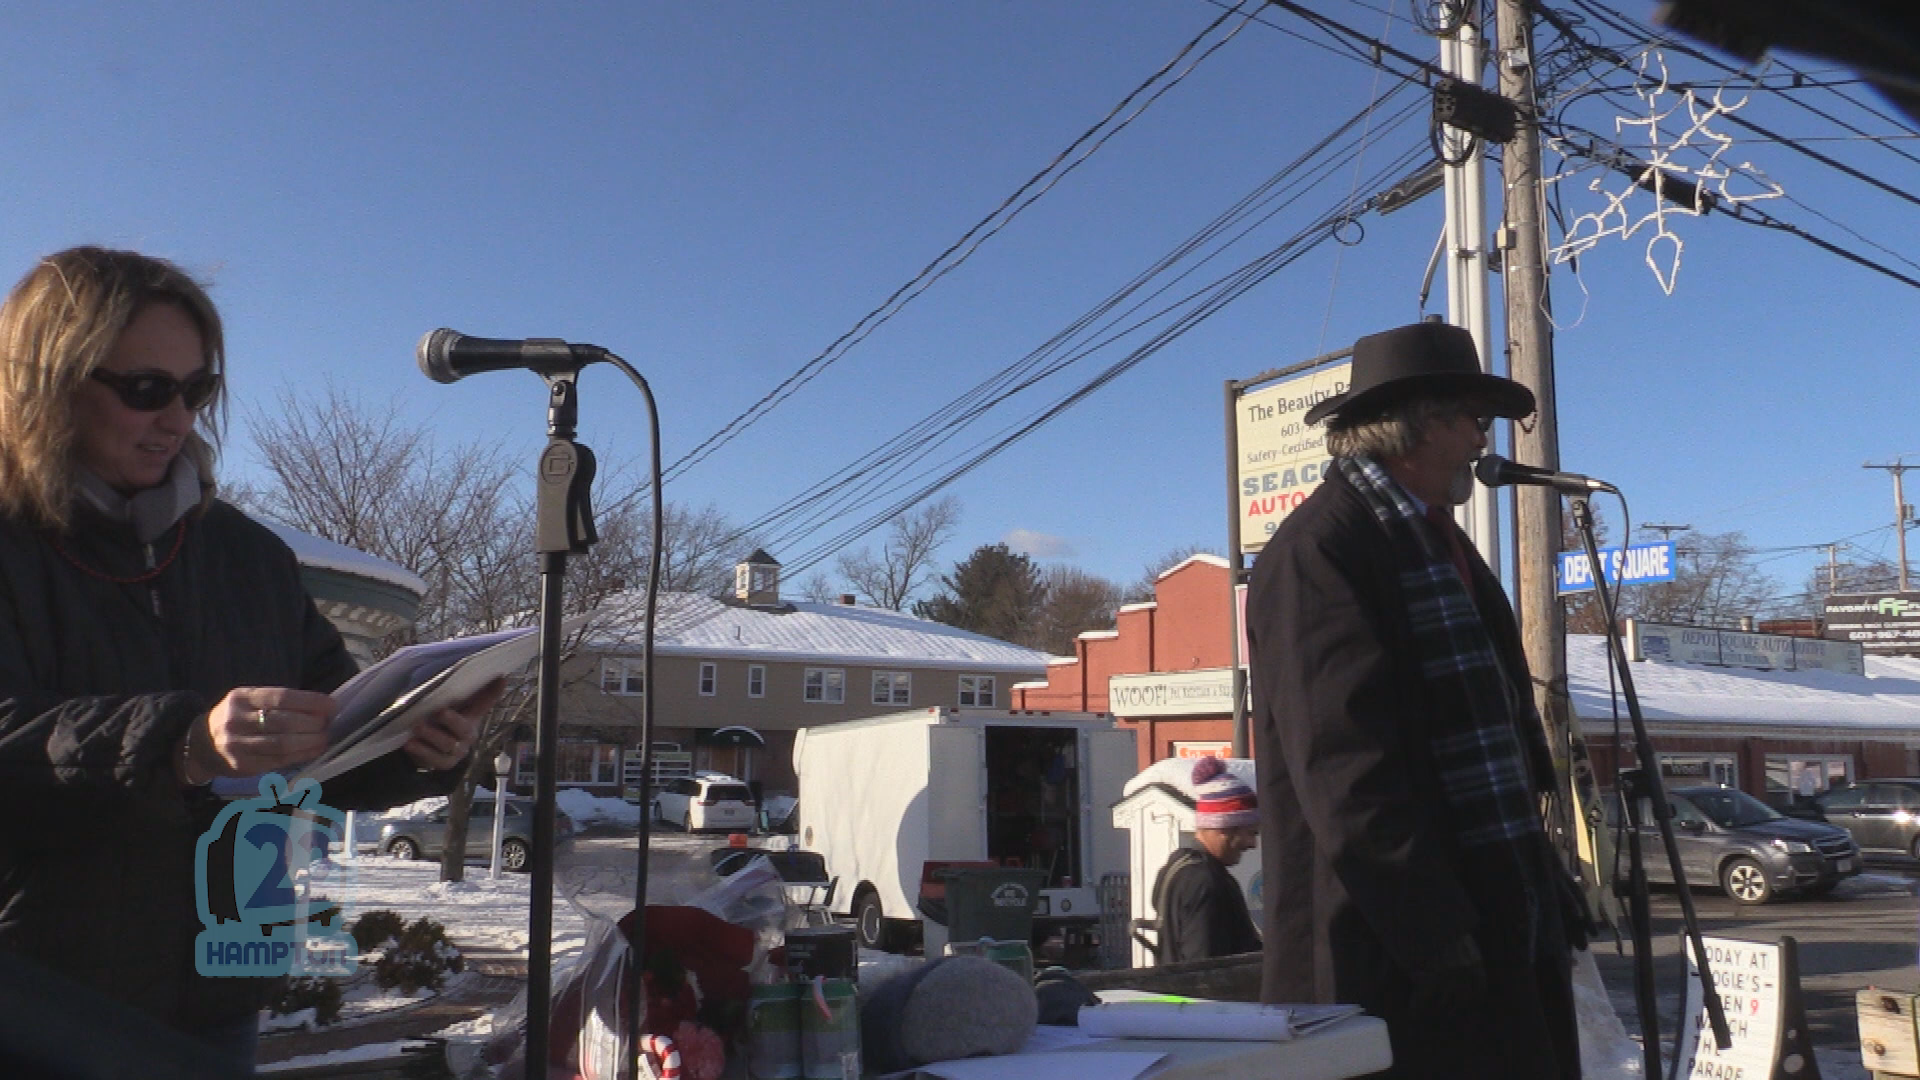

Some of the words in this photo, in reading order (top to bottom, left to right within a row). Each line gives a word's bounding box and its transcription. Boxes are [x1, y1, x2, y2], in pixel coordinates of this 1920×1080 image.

[1248, 404, 1273, 423] The
[1278, 389, 1330, 415] Beauty
[1248, 490, 1306, 517] AUTO
[1564, 552, 1607, 585] DEPT
[1612, 545, 1669, 580] SQUARE
[1113, 683, 1167, 708] WOOF!
[1749, 951, 1768, 969] AT
[1750, 999, 1759, 1017] 9
